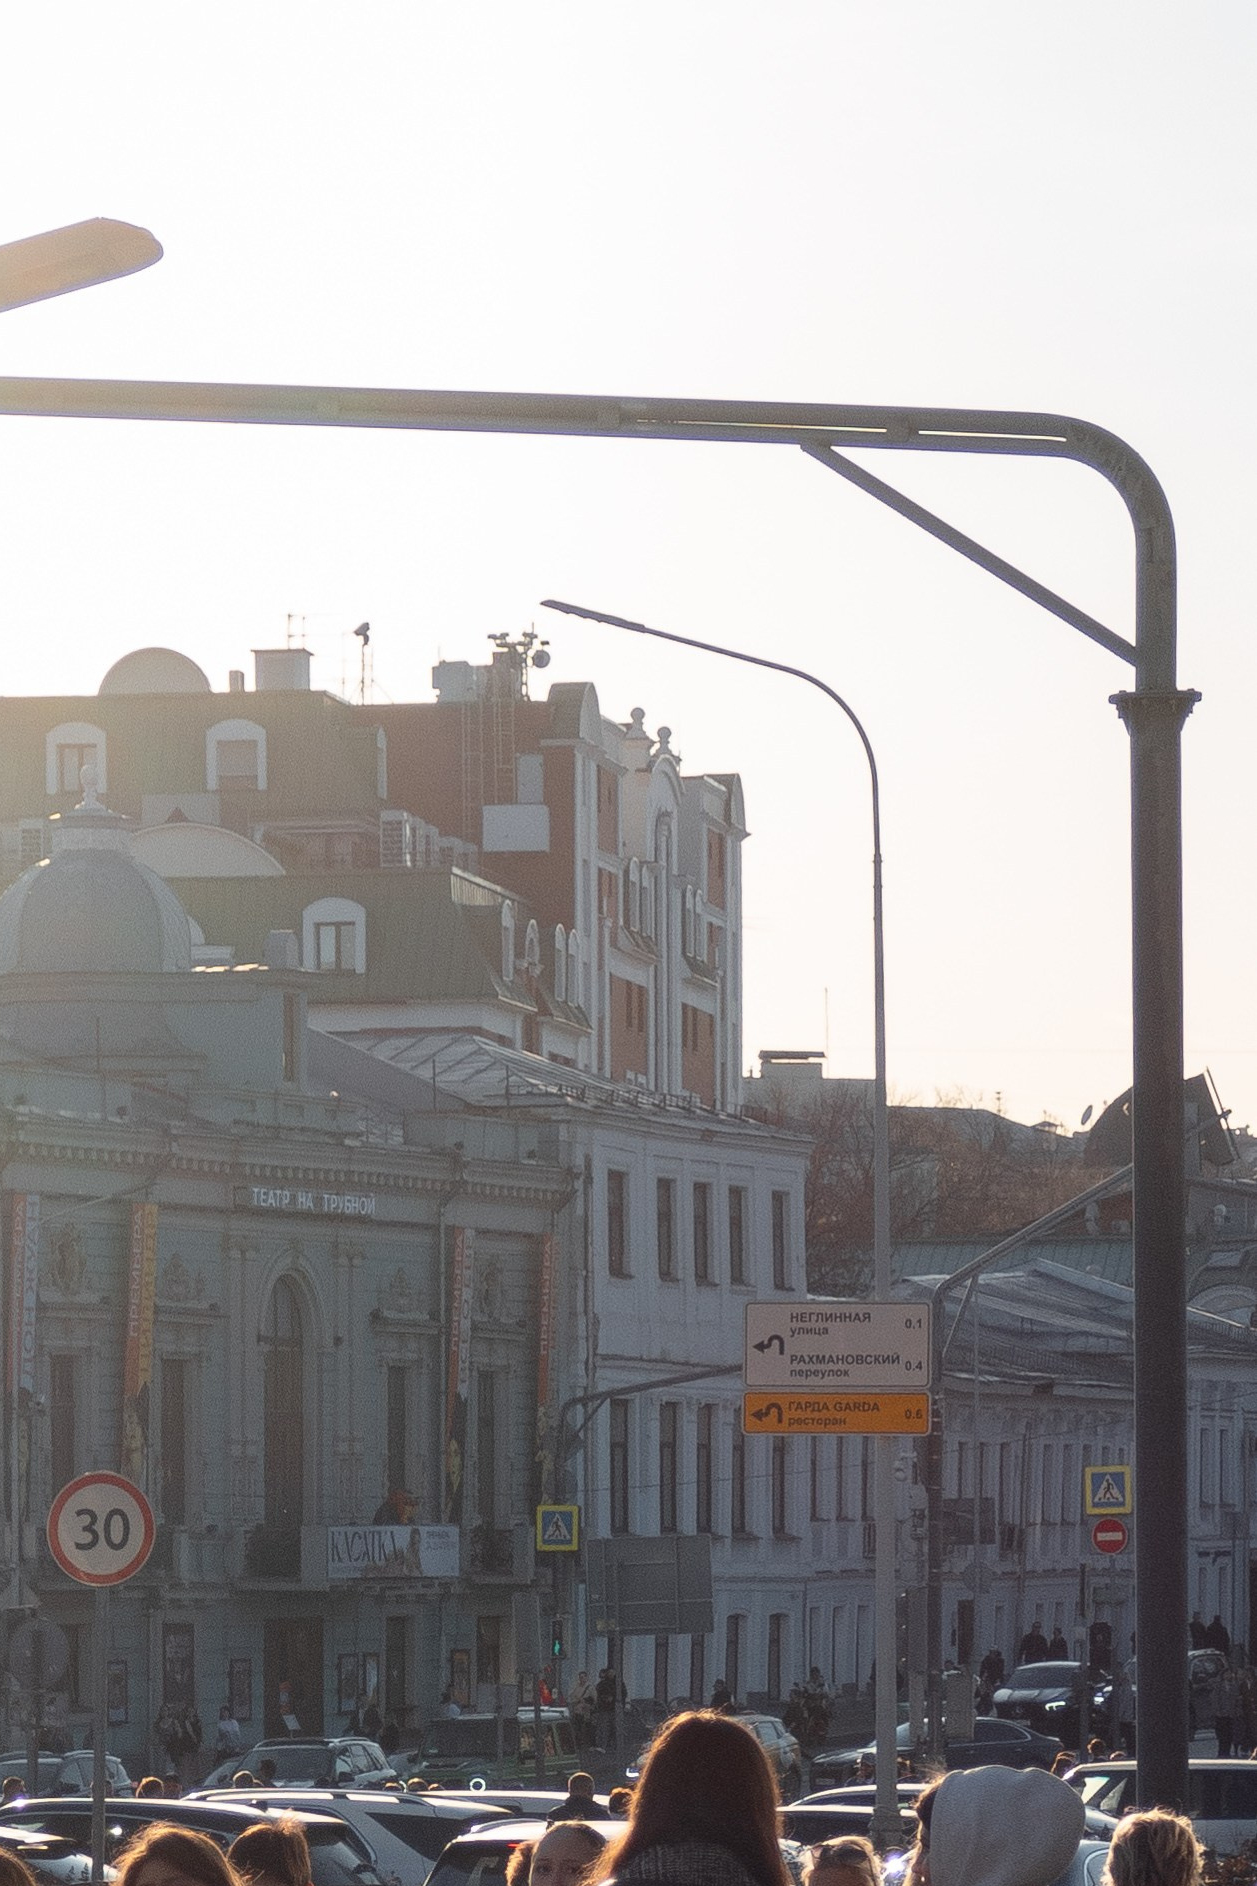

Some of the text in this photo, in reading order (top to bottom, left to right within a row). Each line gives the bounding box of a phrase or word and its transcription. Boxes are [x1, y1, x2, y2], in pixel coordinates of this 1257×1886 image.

[252, 1187, 376, 1215] ТЕАТР НА ТРУБНОЙ
[129, 1209, 143, 1337] ПРЕМЬЕРА
[451, 1235, 463, 1350] ПРЕМЬЕРА
[541, 1241, 552, 1355] ПРЕМЬЕРА
[790, 1312, 923, 1329] НЕГЛИННАЯ 0.1
[790, 1327, 829, 1337] улица
[790, 1352, 923, 1371] РАХМАНОВСКИЙ 0.4
[790, 1368, 850, 1379] переулок
[788, 1401, 830, 1413] ГАРДА
[834, 1402, 880, 1412] GARDA
[788, 1417, 846, 1427] ресторан
[74, 1508, 130, 1551] 30
